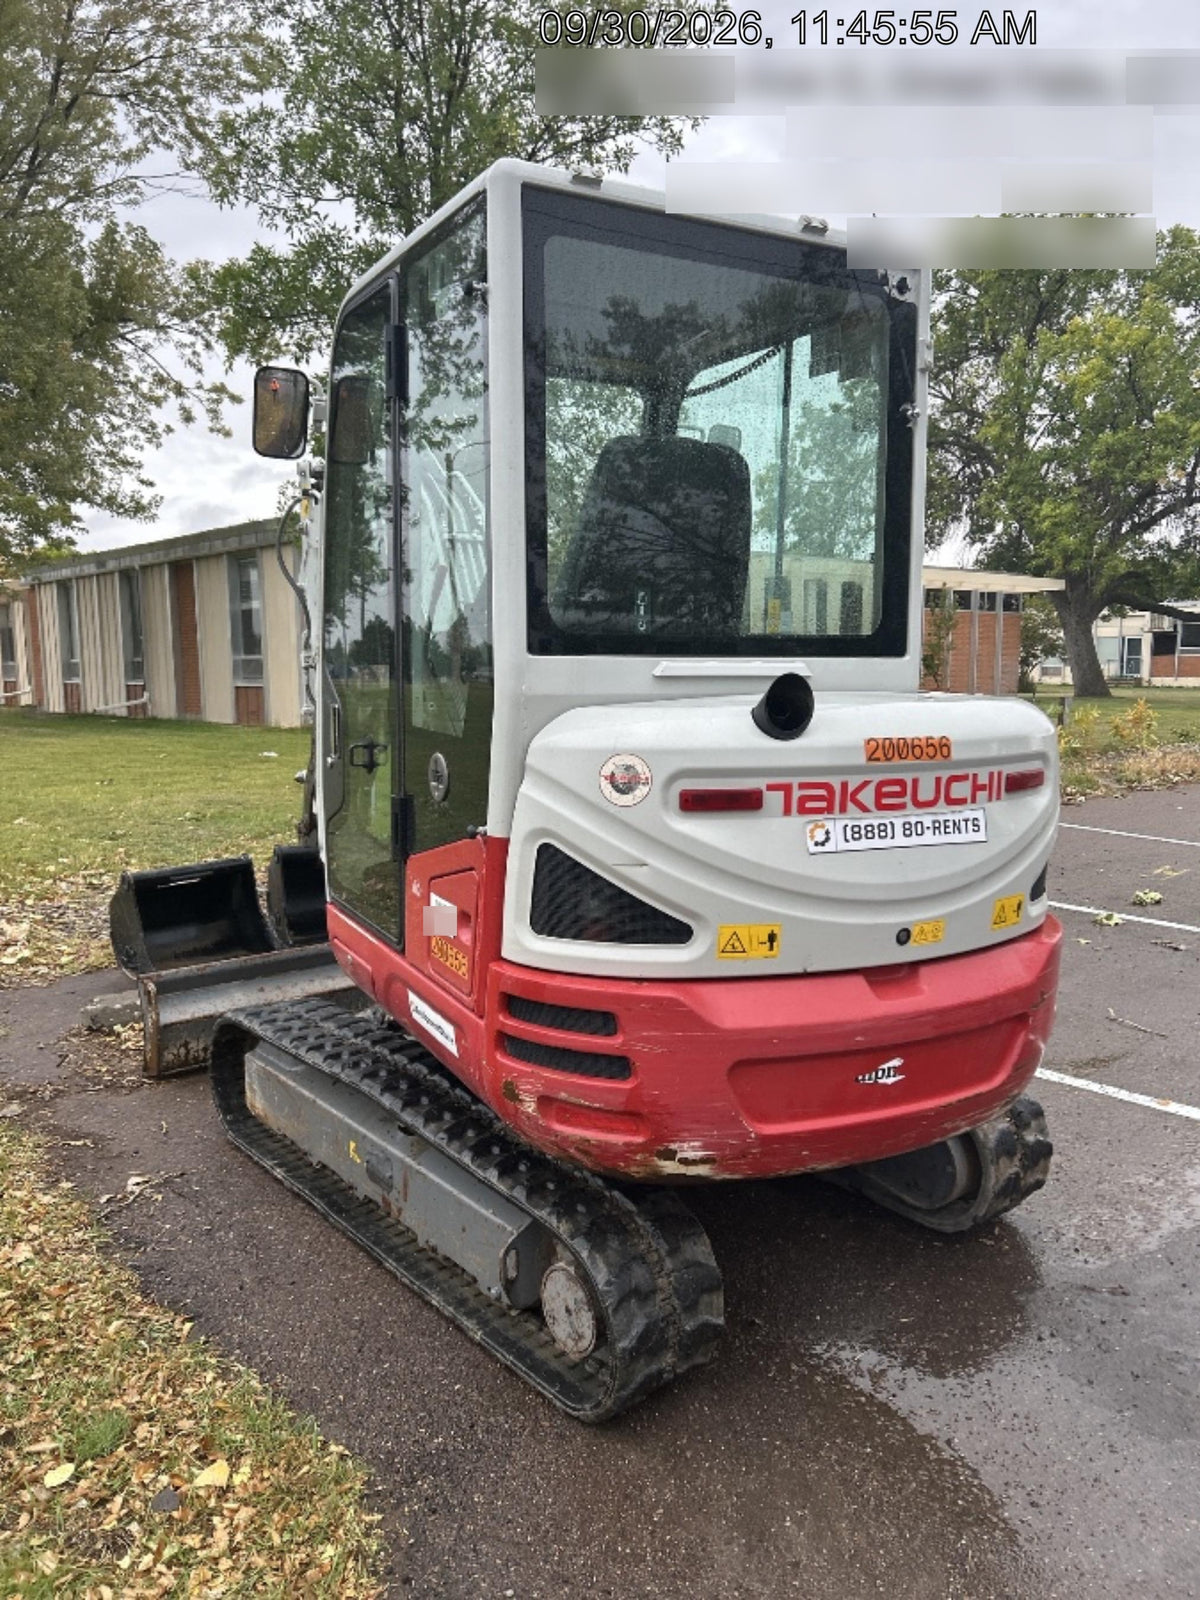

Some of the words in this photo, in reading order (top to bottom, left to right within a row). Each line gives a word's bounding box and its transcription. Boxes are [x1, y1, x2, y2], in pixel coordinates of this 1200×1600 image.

[866, 736, 951, 762] 200656
[843, 821, 896, 843] (888)
[902, 816, 981, 837] 80-RENTS
